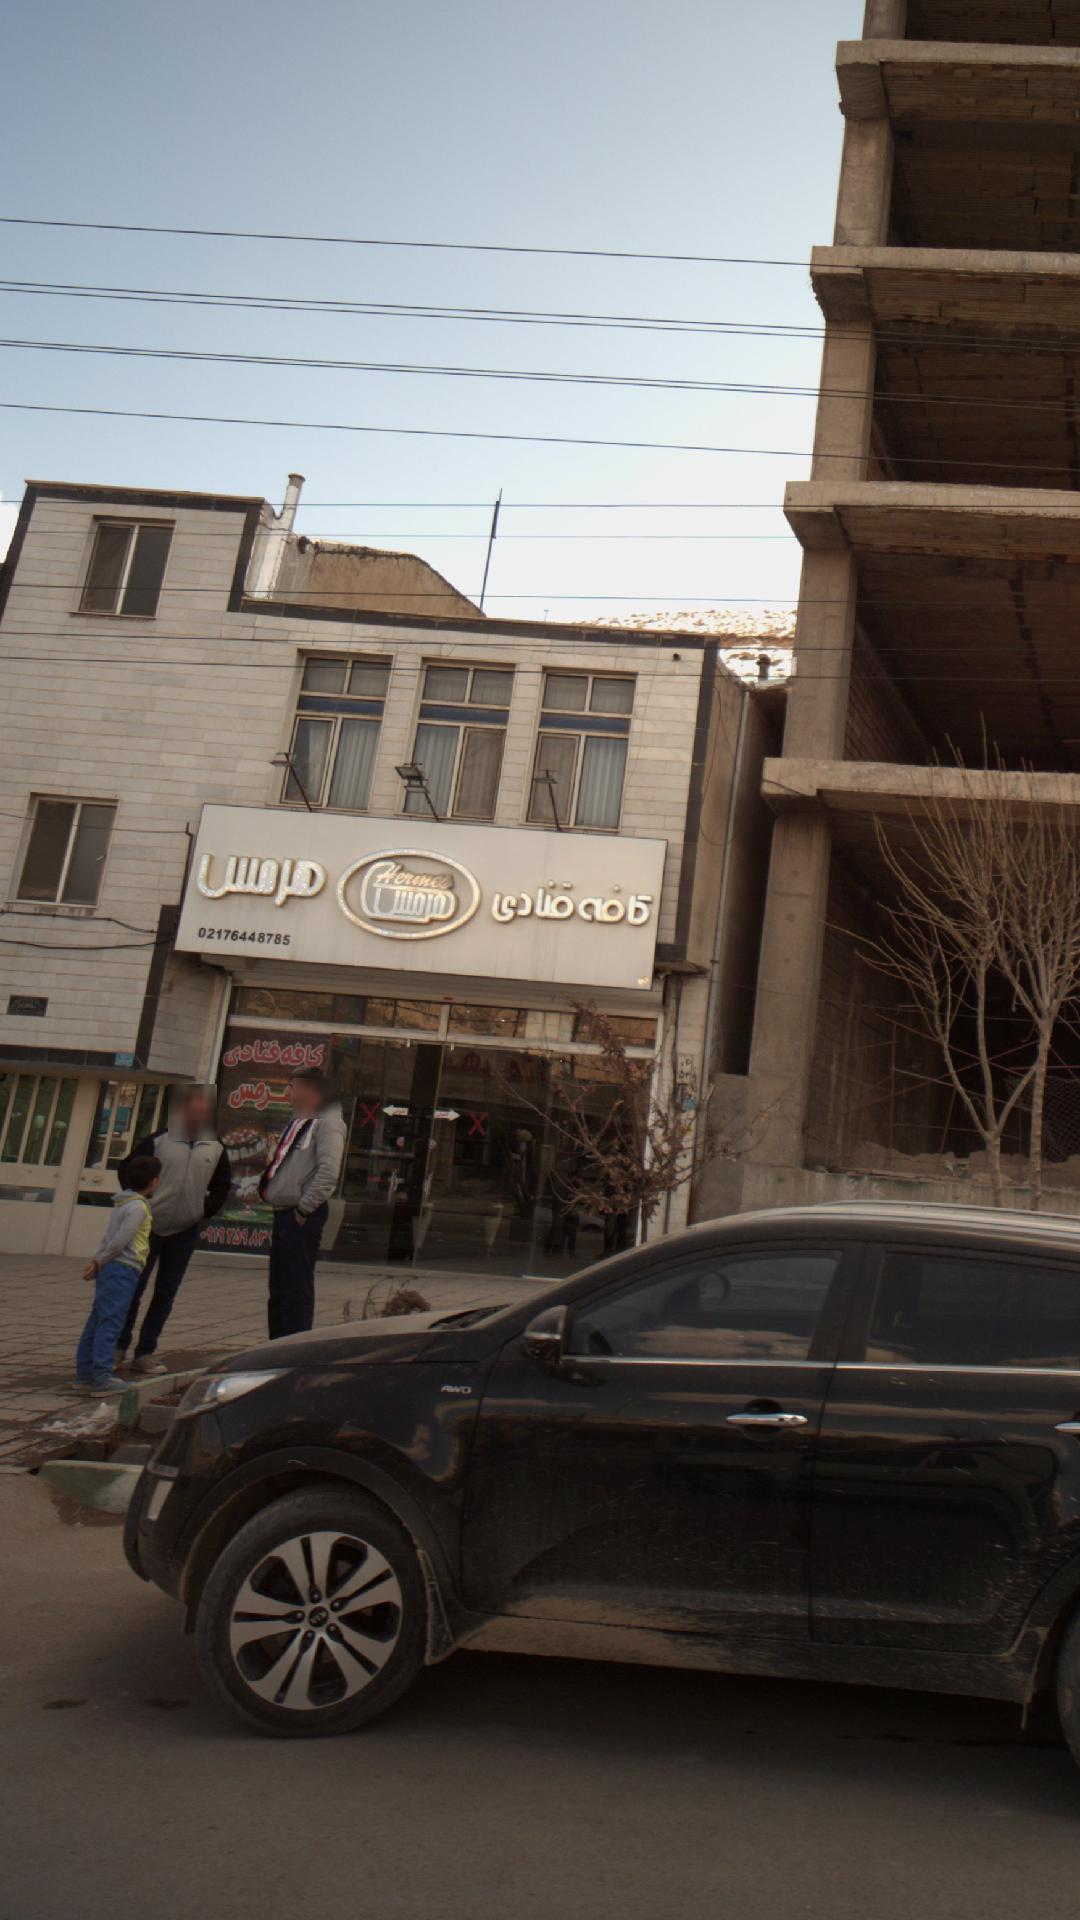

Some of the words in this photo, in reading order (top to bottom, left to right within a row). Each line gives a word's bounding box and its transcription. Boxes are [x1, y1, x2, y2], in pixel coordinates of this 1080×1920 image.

[197, 853, 328, 907] هرمس
[491, 879, 575, 923] قنادی
[578, 884, 653, 926] کافه
[198, 928, 291, 946] 02176448785
[223, 1039, 281, 1067] قنادی
[279, 1042, 325, 1067] کافه
[440, 1385, 473, 1395] AWD
